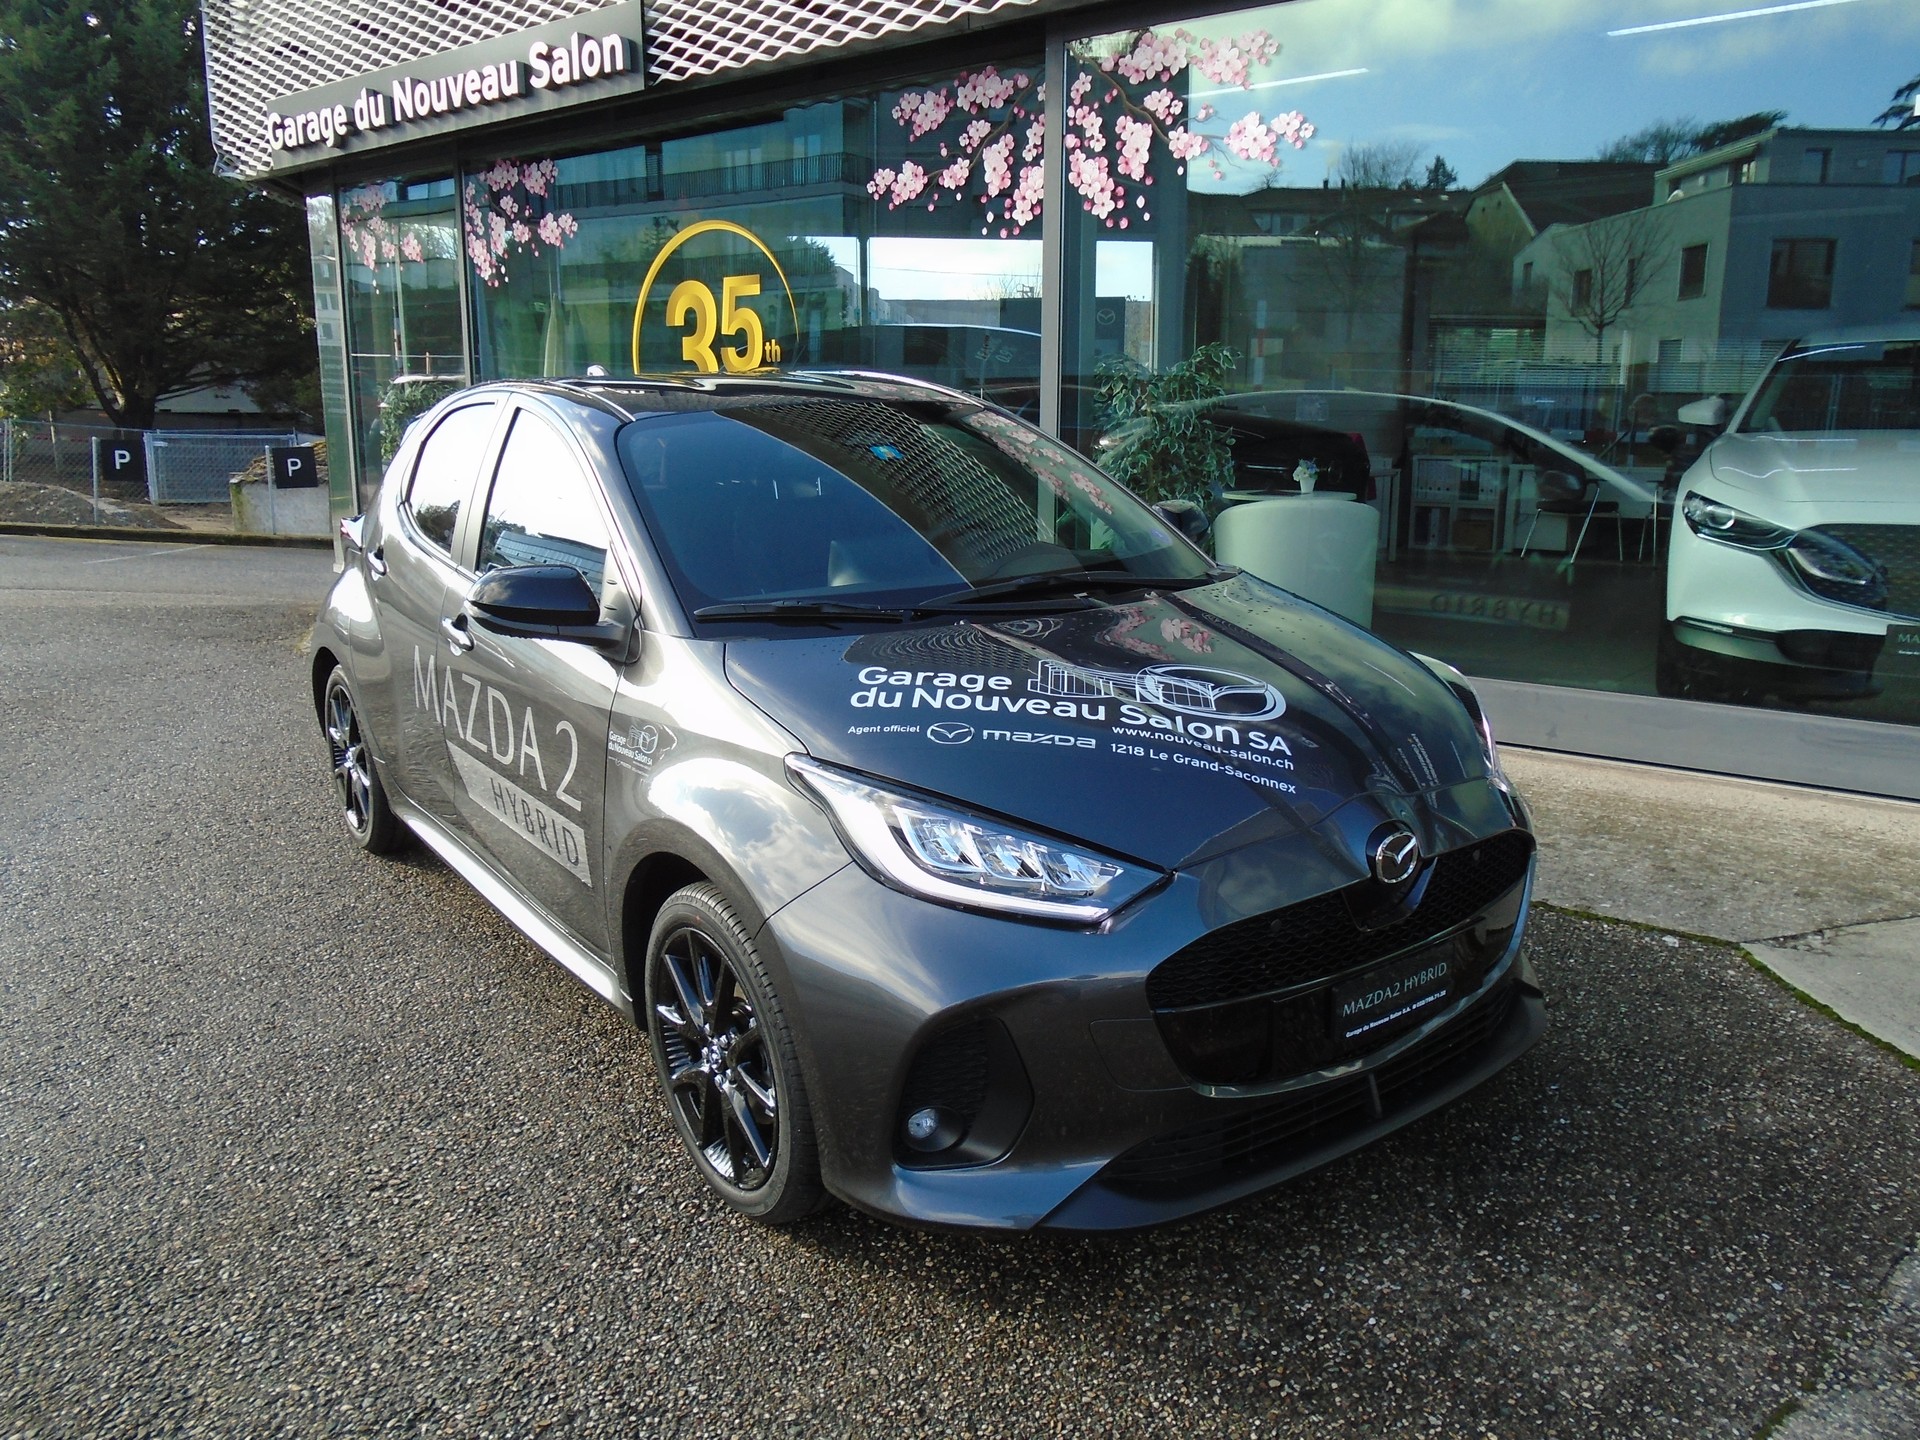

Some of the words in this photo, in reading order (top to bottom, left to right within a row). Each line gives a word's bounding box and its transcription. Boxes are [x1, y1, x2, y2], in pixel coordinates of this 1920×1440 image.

[267, 103, 348, 150] Garage
[354, 87, 387, 131] du
[392, 59, 519, 122] Nouveau
[528, 31, 625, 90] Salon
[114, 450, 131, 470] P
[287, 458, 301, 477] P
[857, 666, 1013, 693] Garage
[413, 645, 547, 791] MAZDA
[556, 720, 582, 812] 2
[609, 731, 626, 745] Garage
[847, 725, 881, 737] Agent
[883, 724, 920, 733] officiel
[982, 729, 1097, 749] mazda
[849, 686, 902, 710] du
[911, 688, 1106, 722] Nouveau
[1119, 703, 1240, 745] Salon
[1248, 731, 1292, 756] SA
[614, 743, 635, 759] Nouveau
[634, 750, 649, 765] Salon
[1110, 743, 1145, 757] 1218
[1149, 748, 1169, 761] Le
[1173, 752, 1297, 795] Grand-Saconnex
[1111, 725, 1295, 771] www.nouveau-salon.ch
[490, 777, 579, 866] HYBRID
[1342, 983, 1400, 1017] MAZDA2
[1404, 963, 1447, 992] HYBRID
